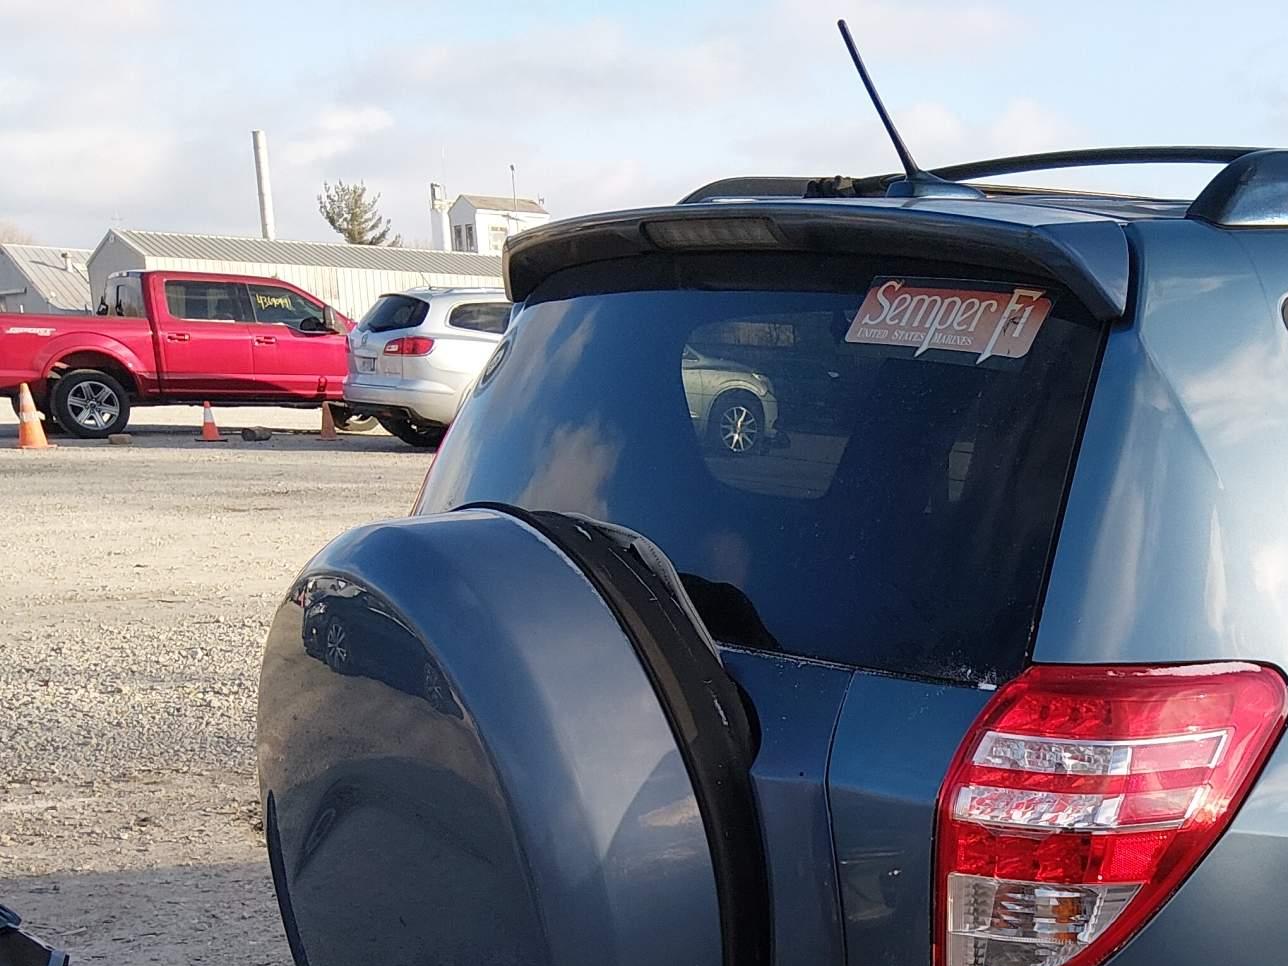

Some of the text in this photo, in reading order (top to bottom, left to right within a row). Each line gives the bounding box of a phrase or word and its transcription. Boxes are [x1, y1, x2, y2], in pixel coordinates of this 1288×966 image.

[857, 327, 975, 347] UNITED STATES MARINES
[862, 280, 998, 358] Semper
